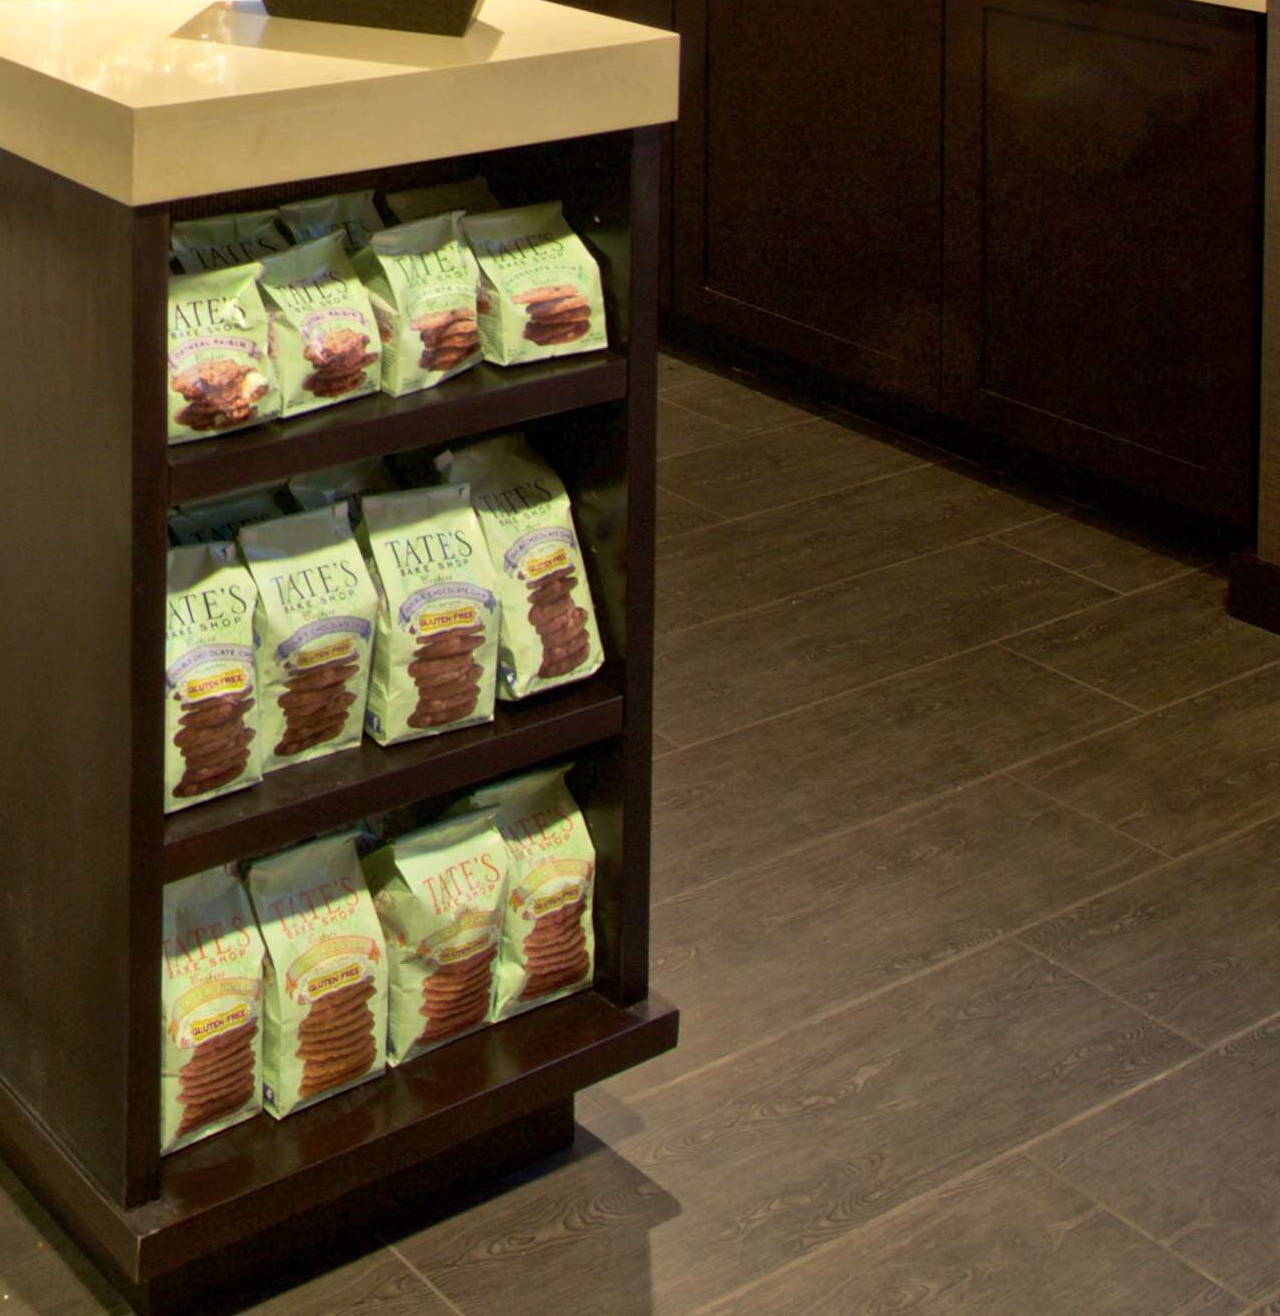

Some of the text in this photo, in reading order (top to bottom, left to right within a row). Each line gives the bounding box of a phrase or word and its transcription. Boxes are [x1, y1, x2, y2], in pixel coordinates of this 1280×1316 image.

[385, 530, 473, 568] TATE'S
[400, 559, 469, 577] BAKE SHOP
[528, 554, 567, 573] GLUTEN FREE
[271, 560, 358, 606] TATE'S
[284, 590, 355, 614] BAKE SHOP
[200, 617, 241, 631] SHOP
[420, 611, 474, 627] GLUTEN FREE
[302, 643, 352, 663] GLUTEN FREE
[188, 674, 243, 694] GLUTEN FREE
[423, 853, 500, 908] TATE'S
[271, 876, 359, 933] TATE'S
[534, 888, 578, 909] GLUTEN FREE
[321, 908, 355, 926] SHOP
[169, 949, 246, 979] BAKE SHOP
[309, 968, 360, 993] GLUTEN FREE
[192, 1010, 245, 1036] GLUTEN FREE
